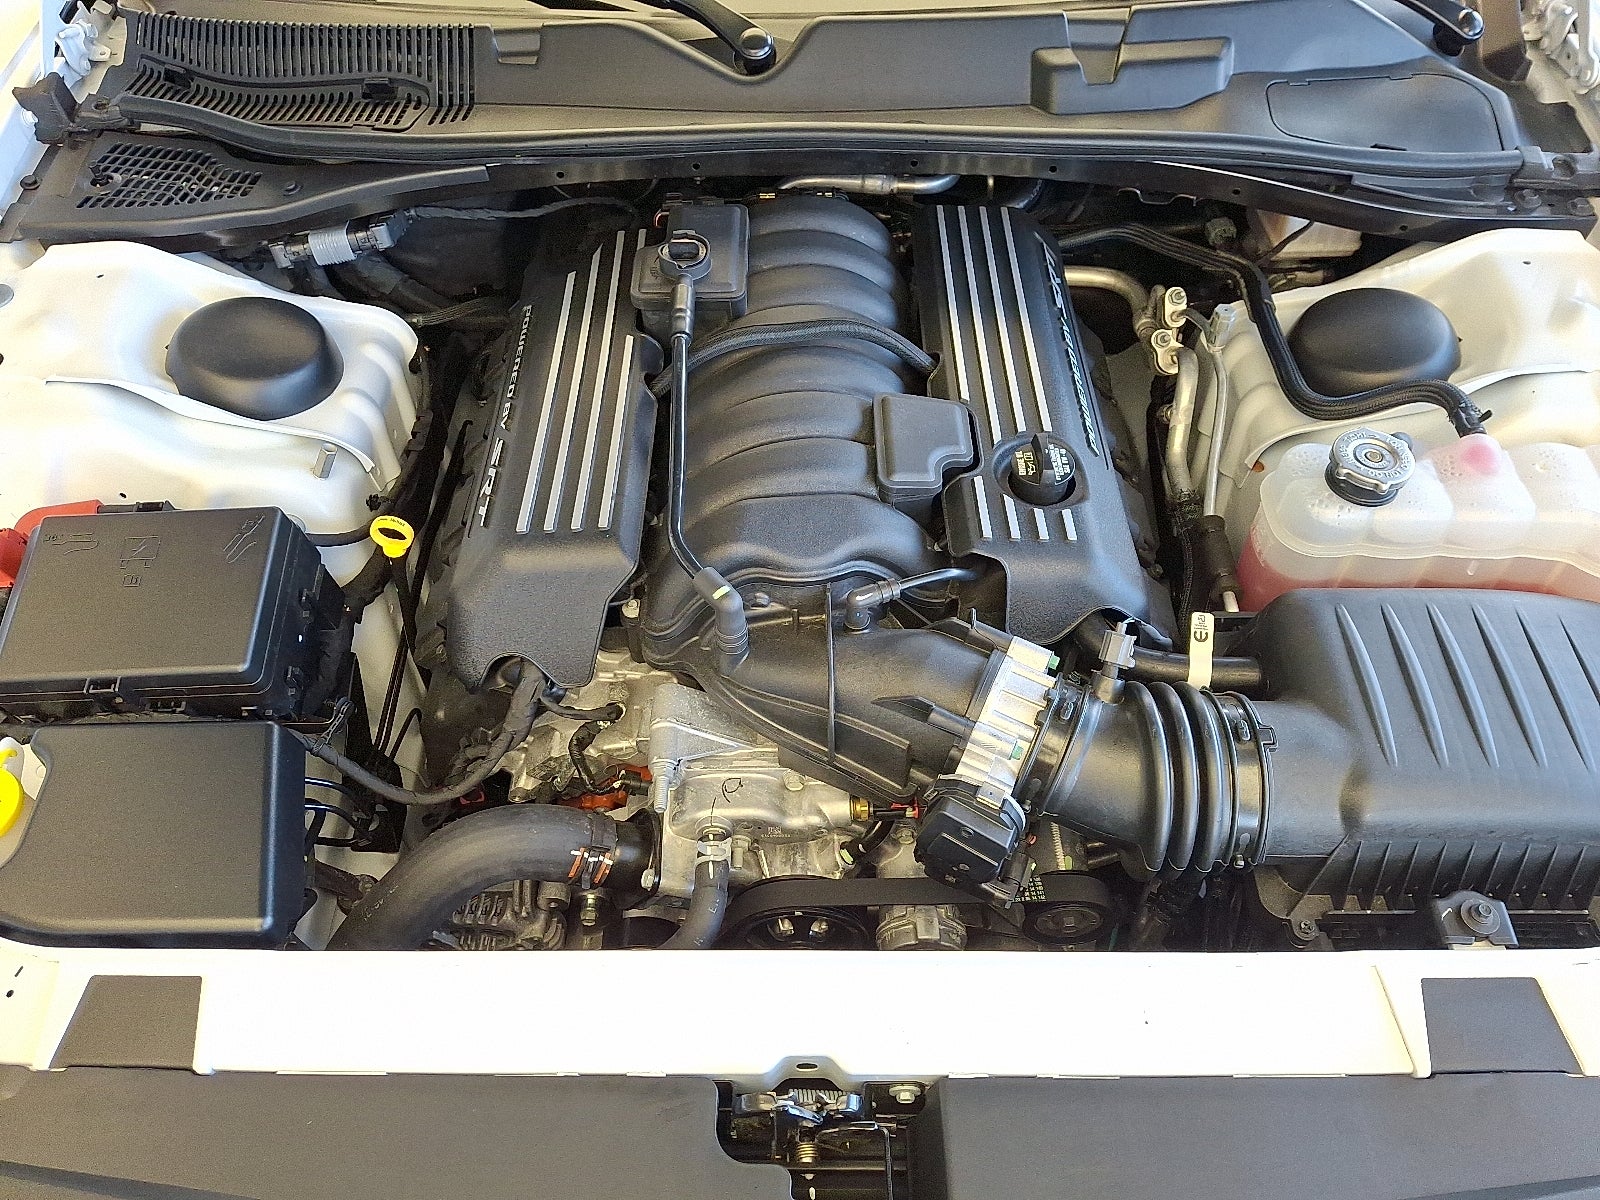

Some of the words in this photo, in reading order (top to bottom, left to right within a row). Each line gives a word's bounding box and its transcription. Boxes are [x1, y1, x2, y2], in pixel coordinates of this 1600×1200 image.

[507, 305, 532, 397] POWERED
[1061, 316, 1074, 348] BY
[501, 402, 511, 429] BY
[1068, 348, 1100, 456] POWERED
[479, 437, 503, 526] SRT
